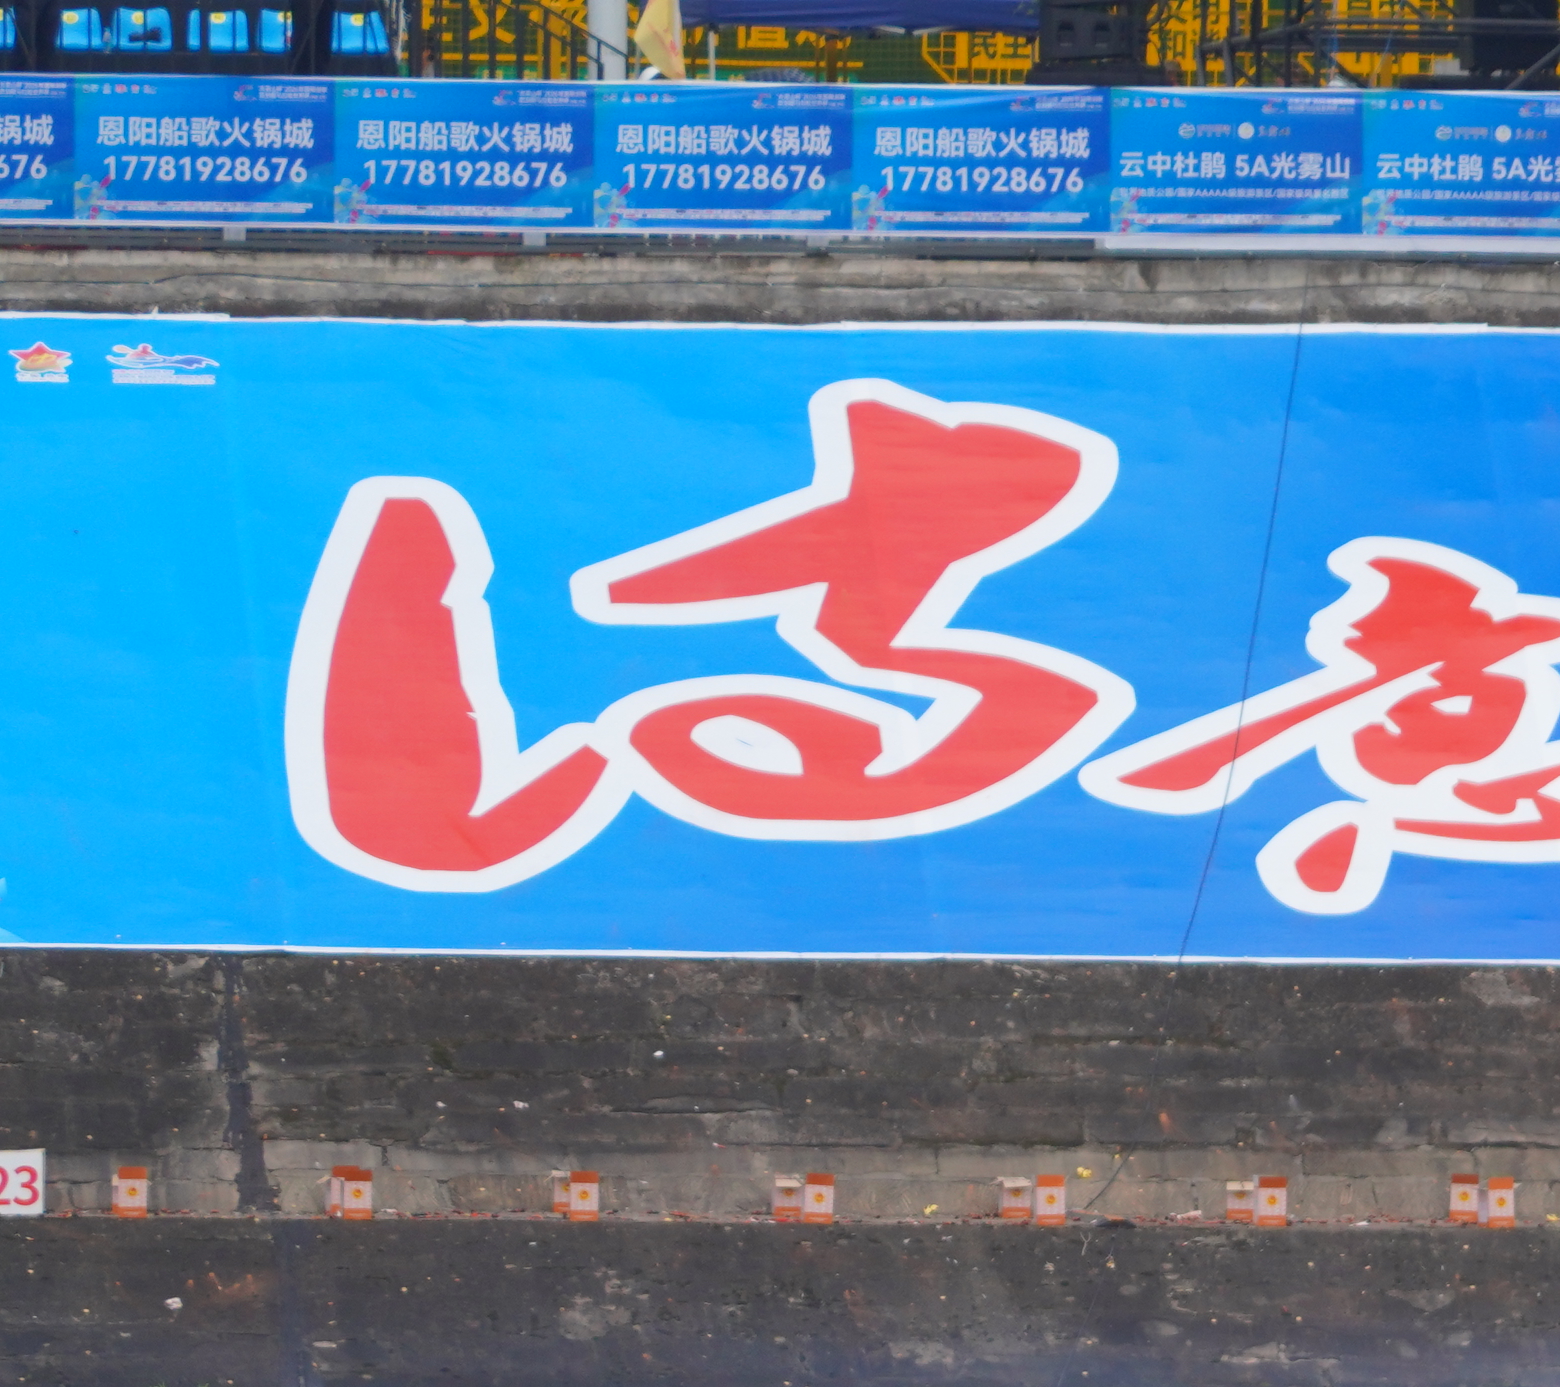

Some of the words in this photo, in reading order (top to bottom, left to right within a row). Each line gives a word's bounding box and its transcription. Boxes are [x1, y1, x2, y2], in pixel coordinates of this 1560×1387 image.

[97, 116, 313, 149] 恩阳船歌火锅城
[357, 120, 573, 153] 恩阳船歌火锅城
[616, 124, 832, 156] 恩阳船歌火锅城
[875, 127, 1090, 159] 恩阳船歌火锅城
[103, 155, 308, 184] 17781928676
[363, 159, 568, 187] 17781928676
[621, 162, 826, 190] 17781928676
[880, 165, 1085, 193] 17781928676
